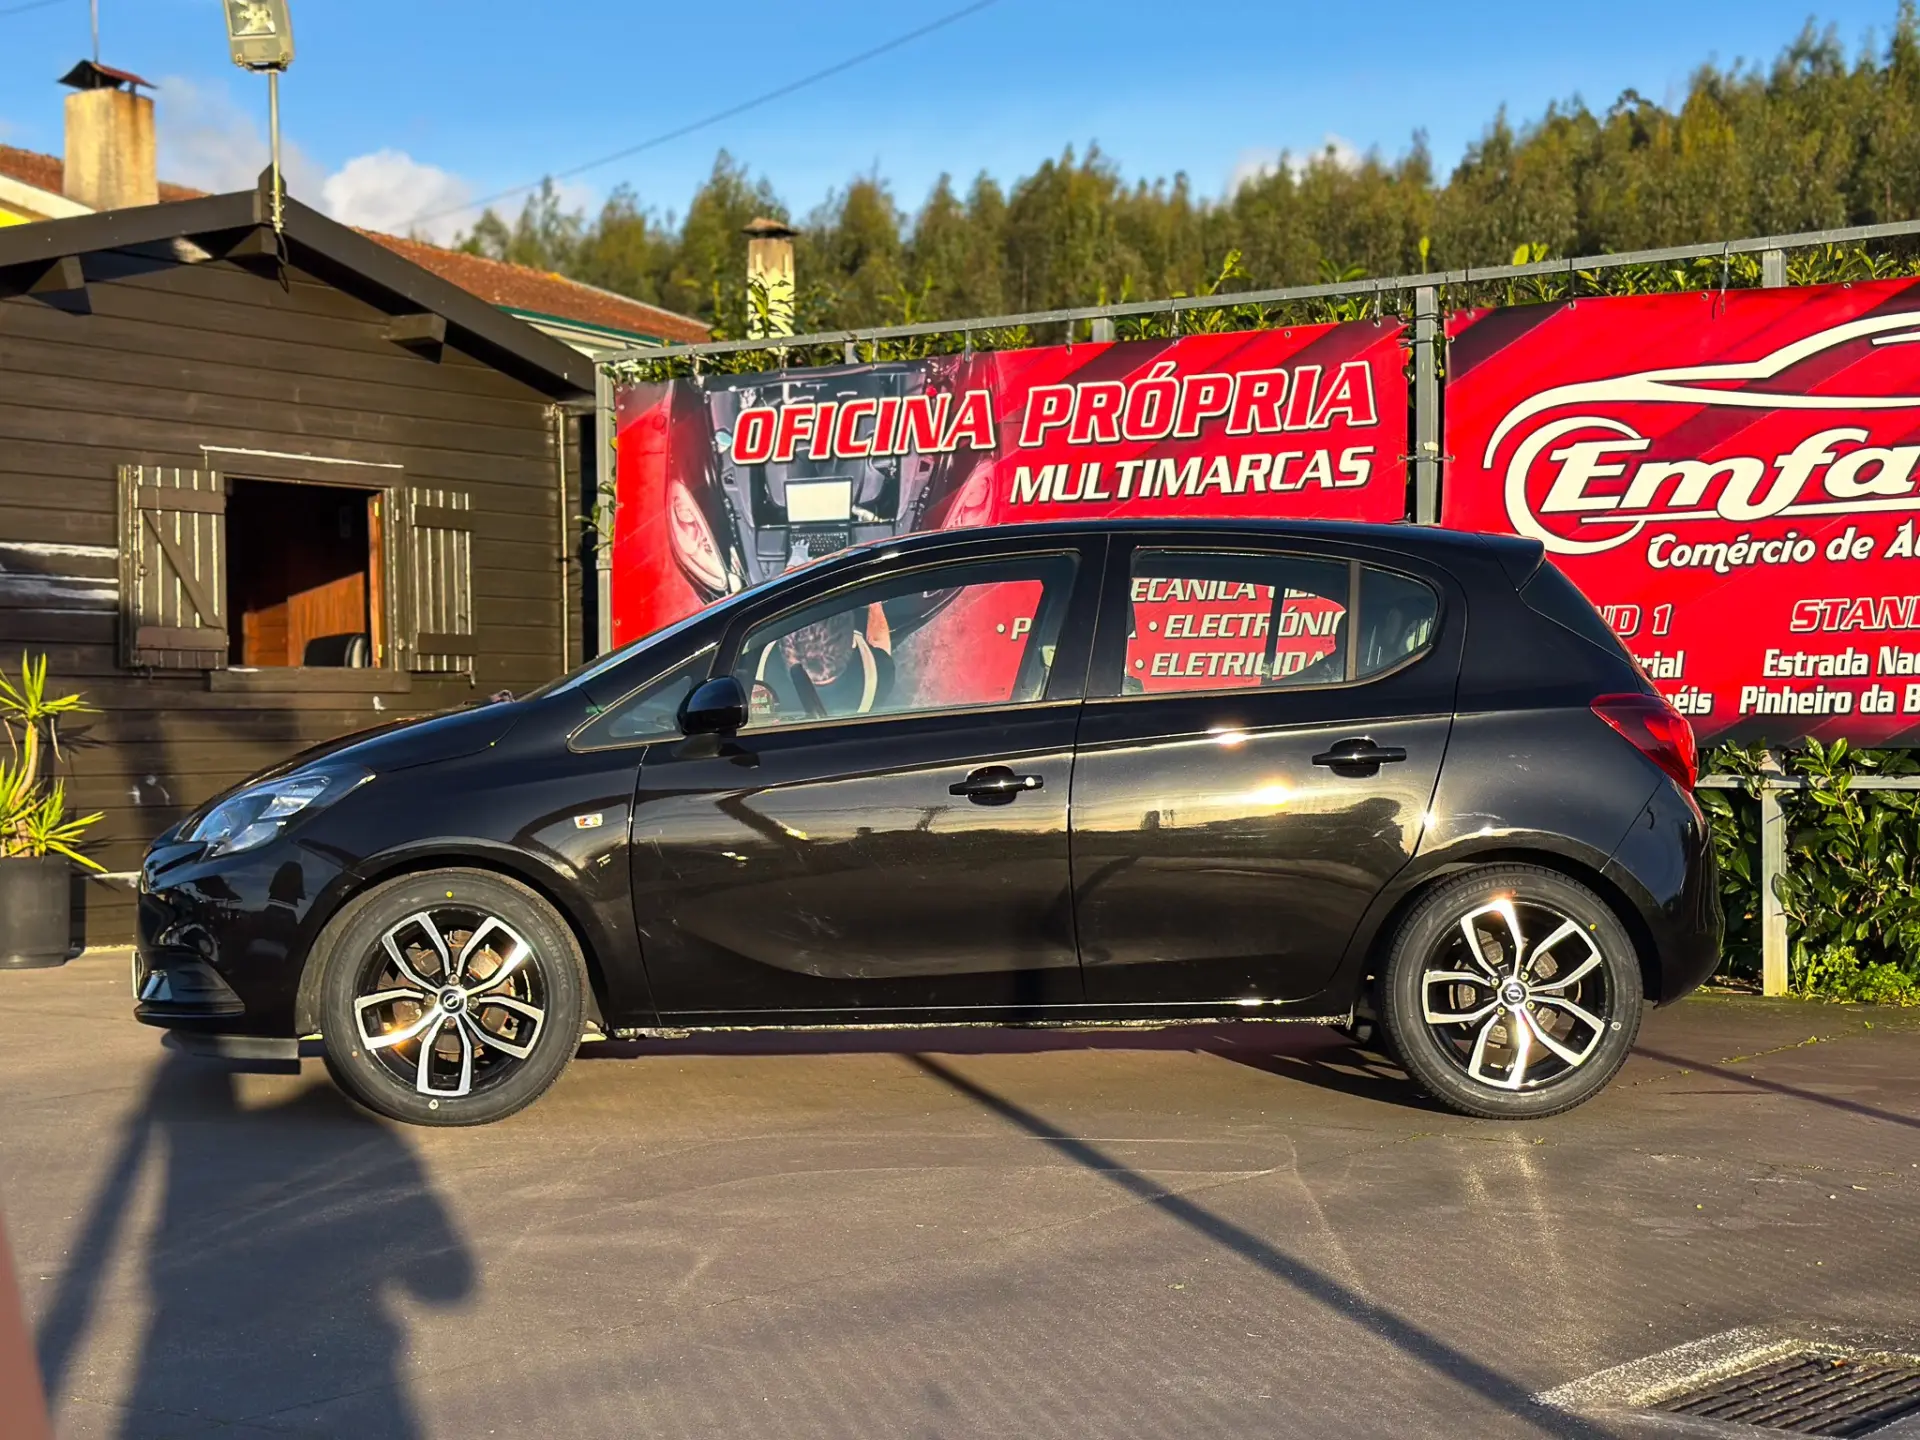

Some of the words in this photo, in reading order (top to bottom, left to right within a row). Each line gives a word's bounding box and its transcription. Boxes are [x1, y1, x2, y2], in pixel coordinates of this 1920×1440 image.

[731, 390, 995, 465] OFICINA
[1019, 360, 1379, 447] PRÓPRIA
[1010, 446, 1374, 504] MULTIMARCAS
[1539, 427, 1920, 522] Emfa
[1647, 532, 1816, 574] Comércio
[1825, 527, 1875, 560] de
[1652, 603, 1673, 636] 1
[1633, 650, 1684, 678] rial
[1763, 647, 1869, 678] Estrada
[1665, 685, 1713, 715] éis
[1739, 685, 1853, 715] Pinheiro
[1860, 684, 1895, 714] da
[1903, 683, 1920, 714] B
